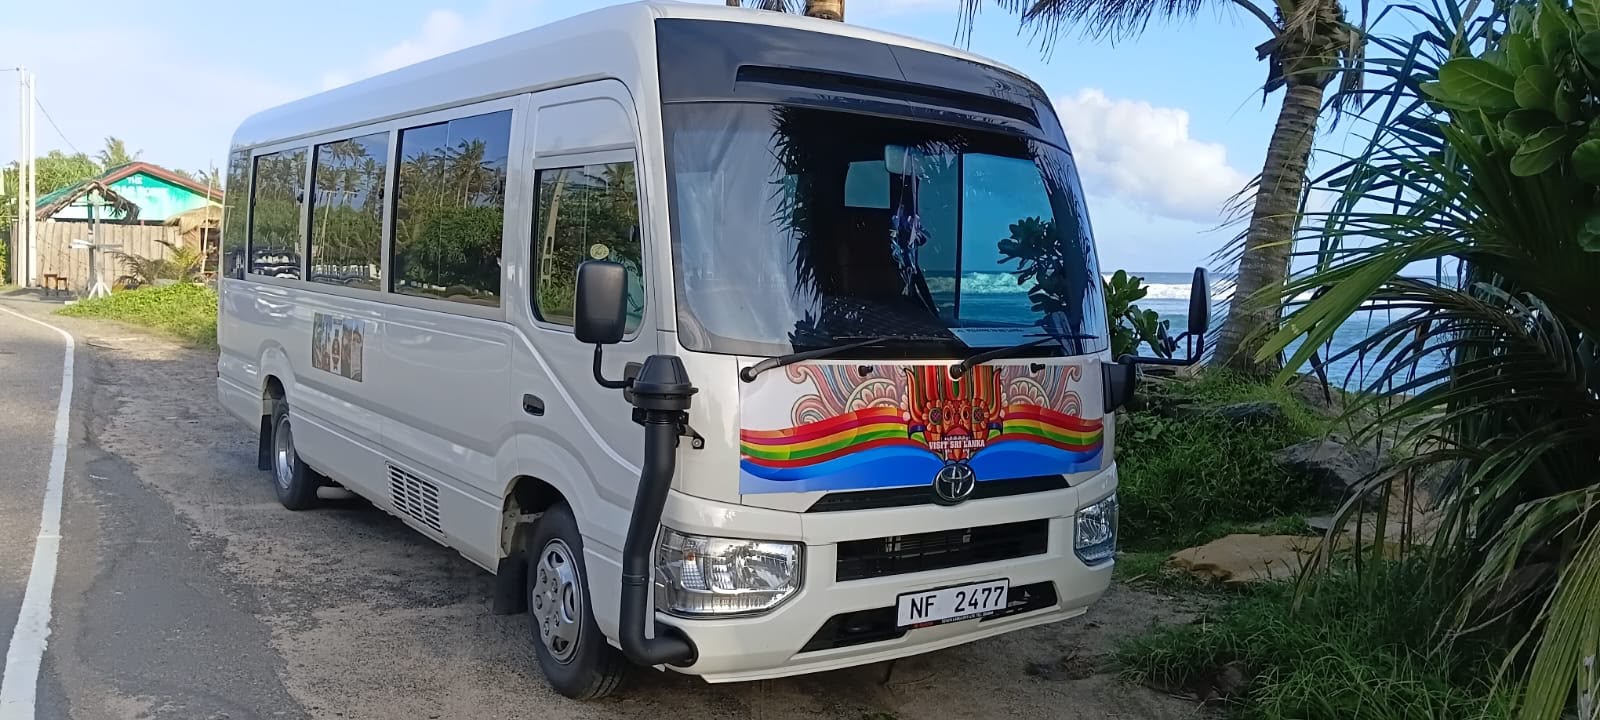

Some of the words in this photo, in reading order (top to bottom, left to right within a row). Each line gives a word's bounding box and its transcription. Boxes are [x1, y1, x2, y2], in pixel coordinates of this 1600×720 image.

[928, 441, 948, 450] VISIT
[949, 440, 962, 449] SRI
[963, 439, 985, 448] LANKA
[910, 594, 937, 620] NF
[954, 585, 1005, 613] 2477
